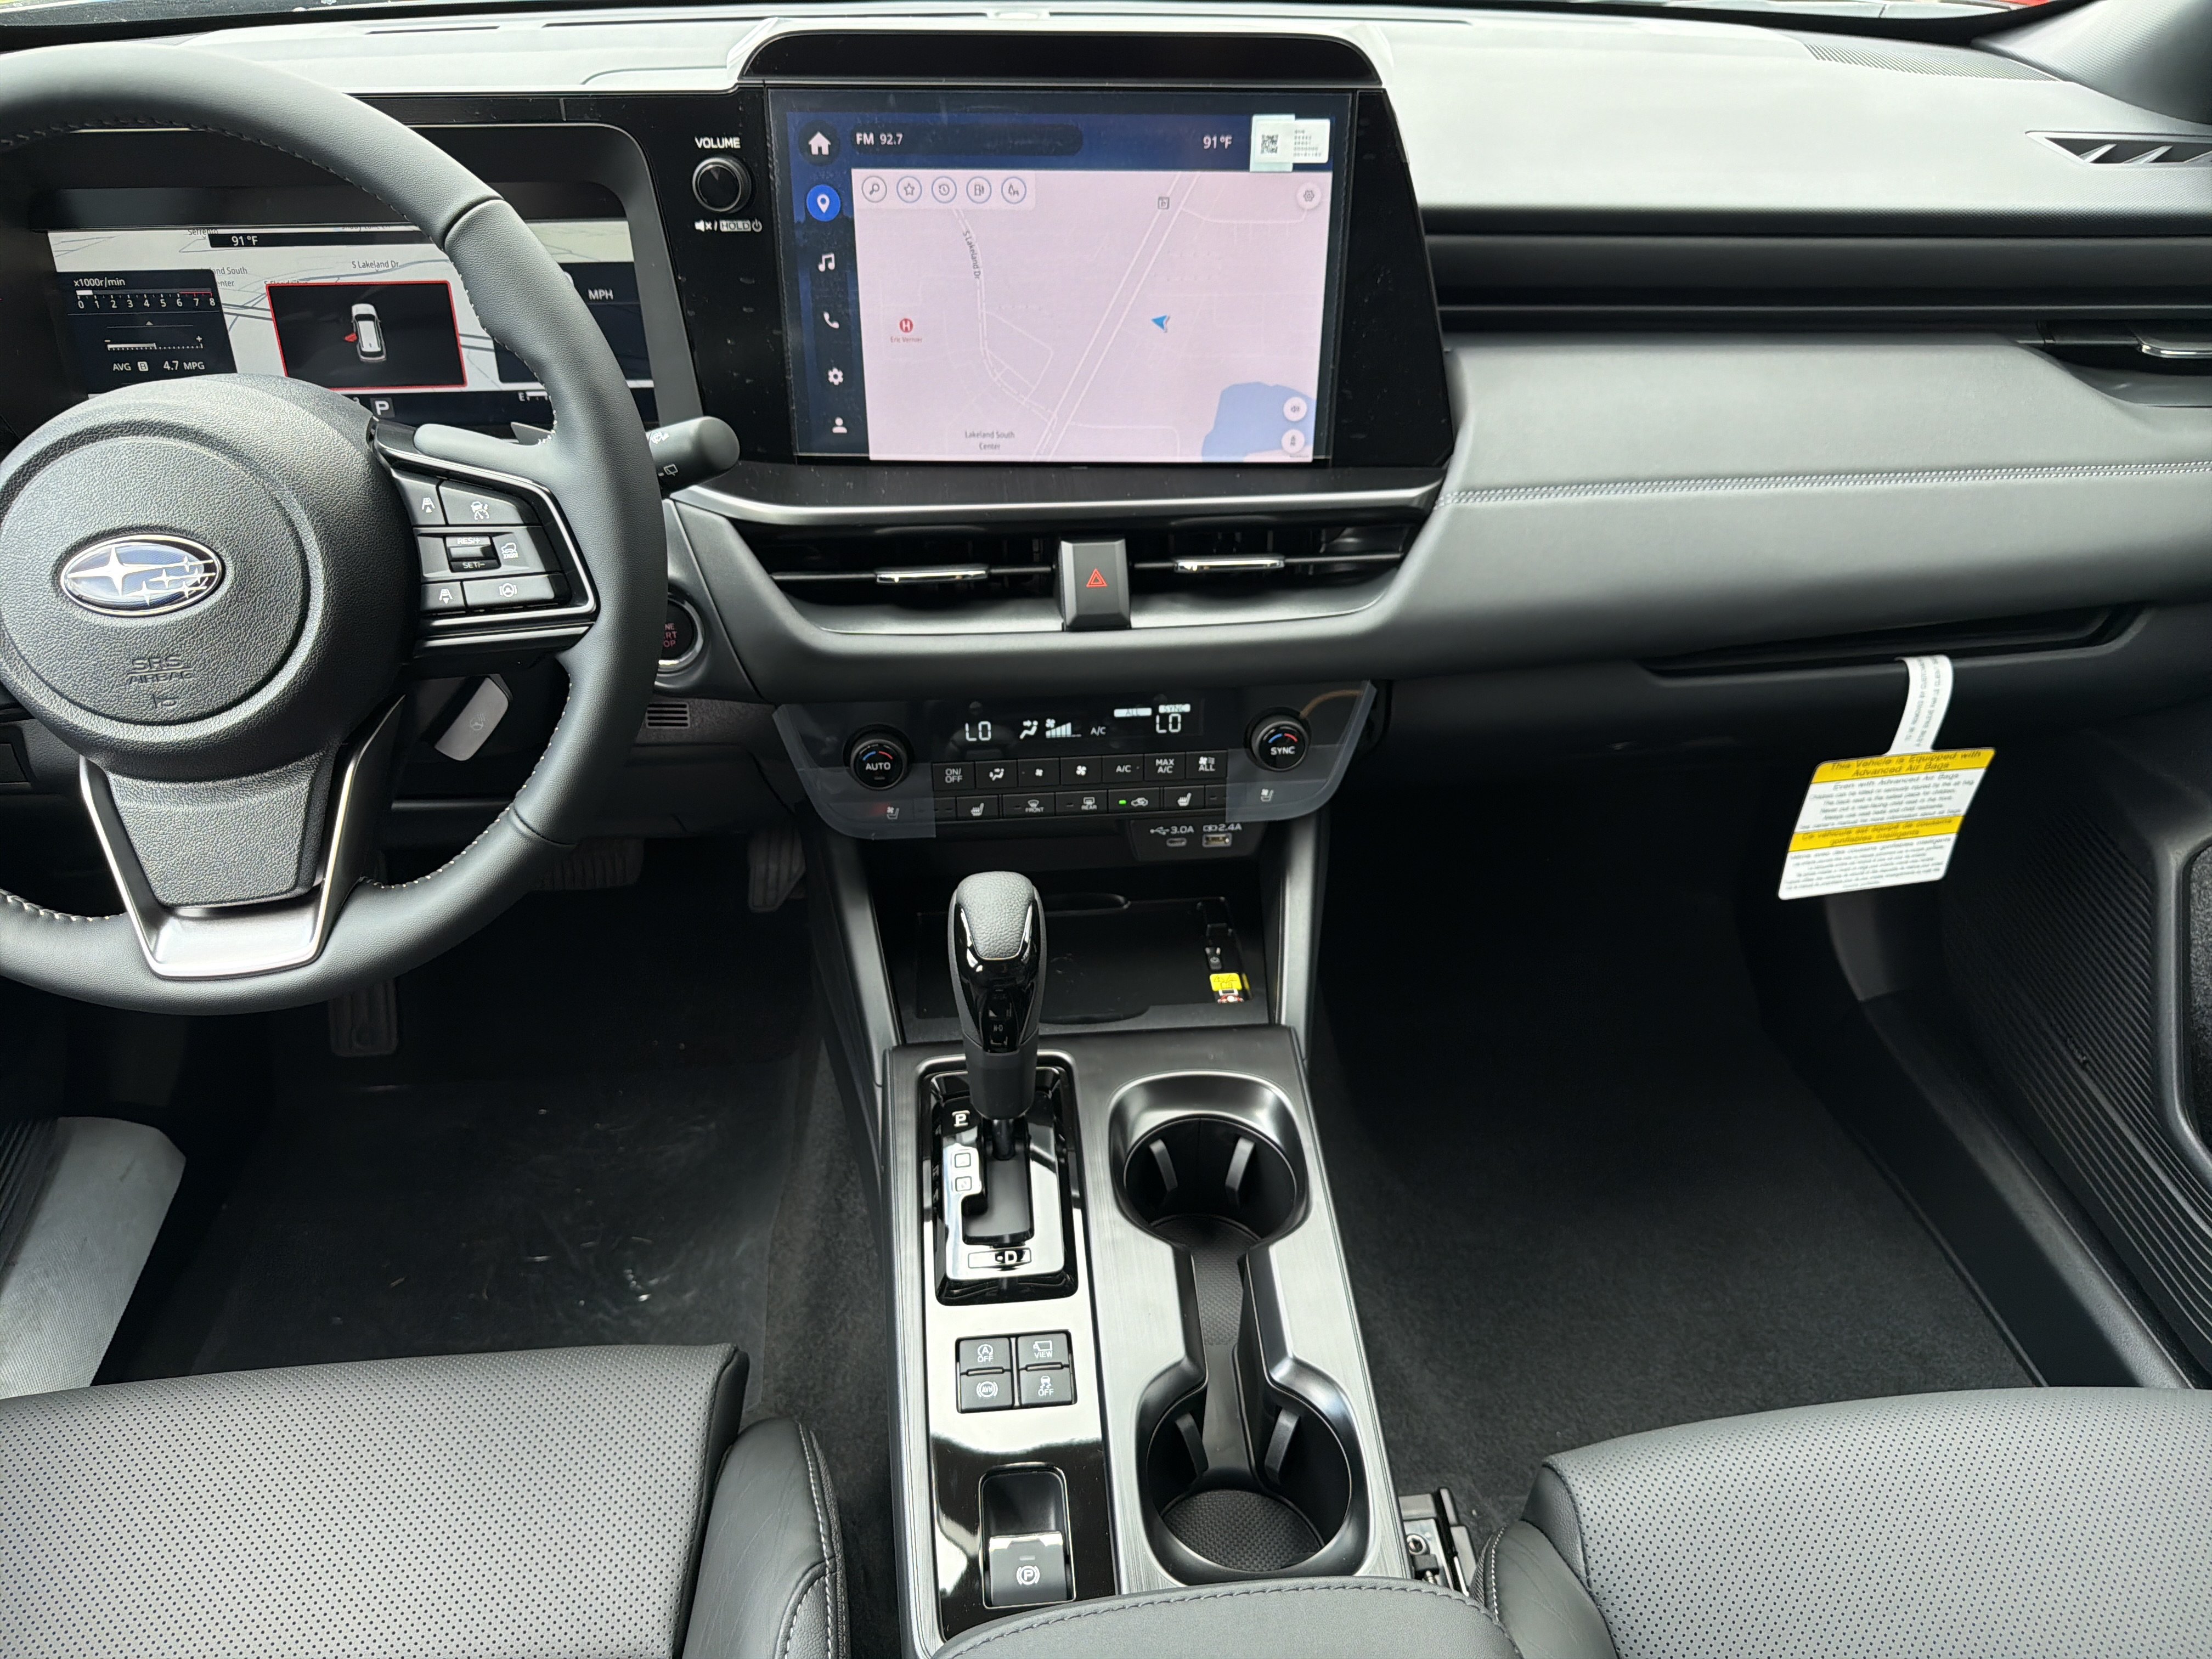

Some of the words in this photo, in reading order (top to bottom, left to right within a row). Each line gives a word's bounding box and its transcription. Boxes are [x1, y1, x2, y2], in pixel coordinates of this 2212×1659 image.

[694, 137, 741, 149] VOLUME
[856, 133, 874, 145] FM
[879, 133, 903, 145] 92.7
[720, 222, 750, 230] HOLD
[966, 236, 979, 269] Lakeland
[973, 270, 981, 279] Dr
[358, 260, 390, 268] Lakeland
[391, 260, 399, 268] Dr
[227, 266, 248, 274] South
[74, 278, 126, 287] x1000r/min
[588, 289, 613, 300] MPH
[78, 301, 84, 309] 0
[94, 300, 100, 308] 1
[110, 300, 117, 308] 2
[127, 300, 133, 308] 3
[160, 299, 166, 307] 5
[194, 298, 199, 307] 7
[210, 298, 216, 306] 8
[112, 363, 132, 371] AVG
[163, 360, 179, 370] 4.7
[183, 362, 205, 370] MPG
[518, 392, 525, 401] E
[375, 400, 390, 415] P
[965, 430, 995, 439] Lakeland
[995, 430, 1015, 439] South
[979, 442, 1001, 450] Center
[132, 656, 184, 671] SRS
[128, 670, 193, 685] AIRBAG
[1156, 713, 1181, 733] LO
[965, 720, 991, 741] LO
[1090, 726, 1107, 736] A/C
[1270, 746, 1295, 755] SYNC
[1155, 758, 1175, 766] MAX
[1830, 761, 1852, 770] This
[1854, 758, 1892, 768] Vehicle
[1894, 757, 1905, 765] is
[1908, 752, 1957, 764] Equipped
[1959, 750, 1982, 759] with
[865, 761, 891, 771] AUTO
[1115, 764, 1131, 773] A/C
[1157, 765, 1173, 774] A/C
[1198, 763, 1215, 772] ALL
[1851, 765, 1903, 777] Advanced
[1923, 761, 1951, 770] Bags
[945, 775, 963, 783] OFF
[1832, 781, 1856, 790] Even
[1857, 780, 1876, 788] with
[1877, 776, 1920, 786] Advanced
[1170, 825, 1194, 834] 3.0A
[955, 1114, 967, 1126] P
[981, 1385, 994, 1393] AVH
[1038, 1388, 1054, 1396] OFF
